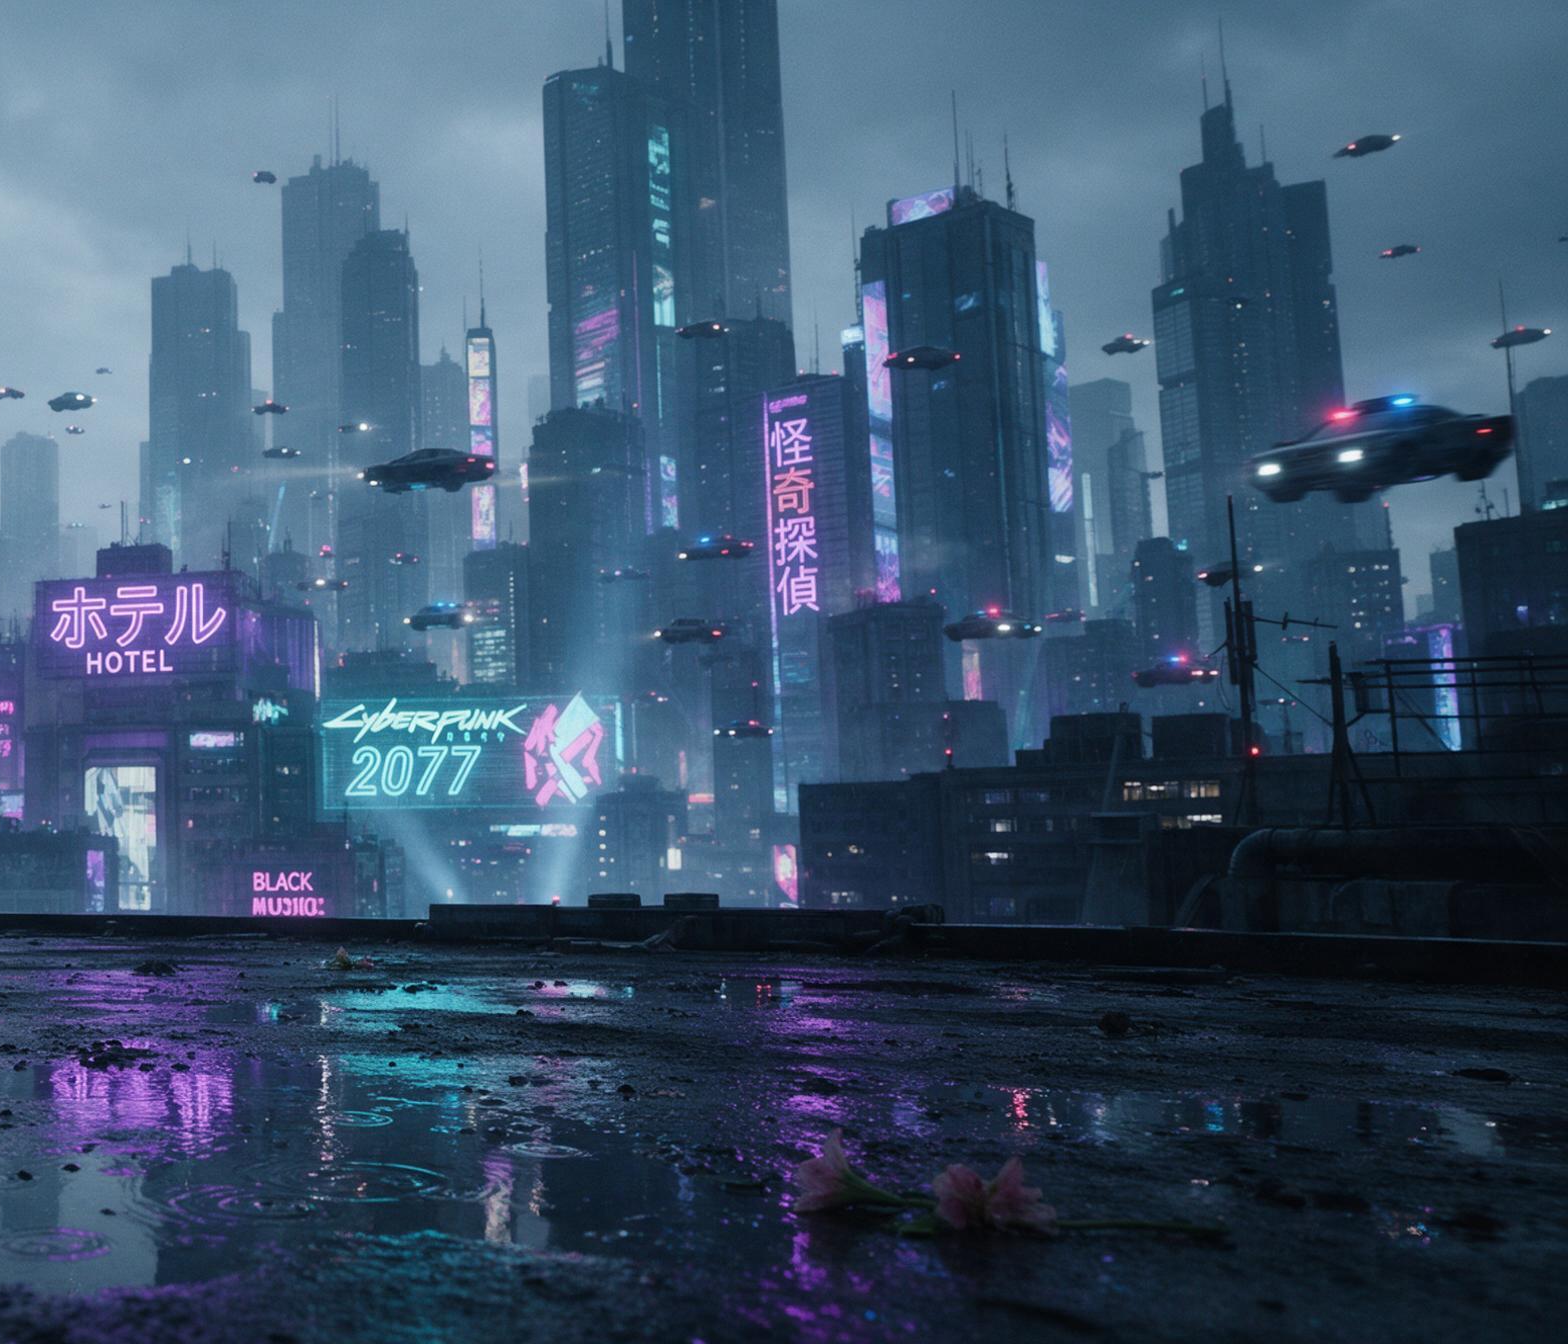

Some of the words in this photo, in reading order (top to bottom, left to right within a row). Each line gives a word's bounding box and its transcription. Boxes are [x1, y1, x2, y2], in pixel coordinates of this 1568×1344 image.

[770, 418, 820, 616] 怪奇探偵
[50, 583, 227, 649] ホテル
[86, 649, 174, 675] HOTEL
[344, 745, 482, 797] 2077
[252, 871, 314, 892] BLACK
